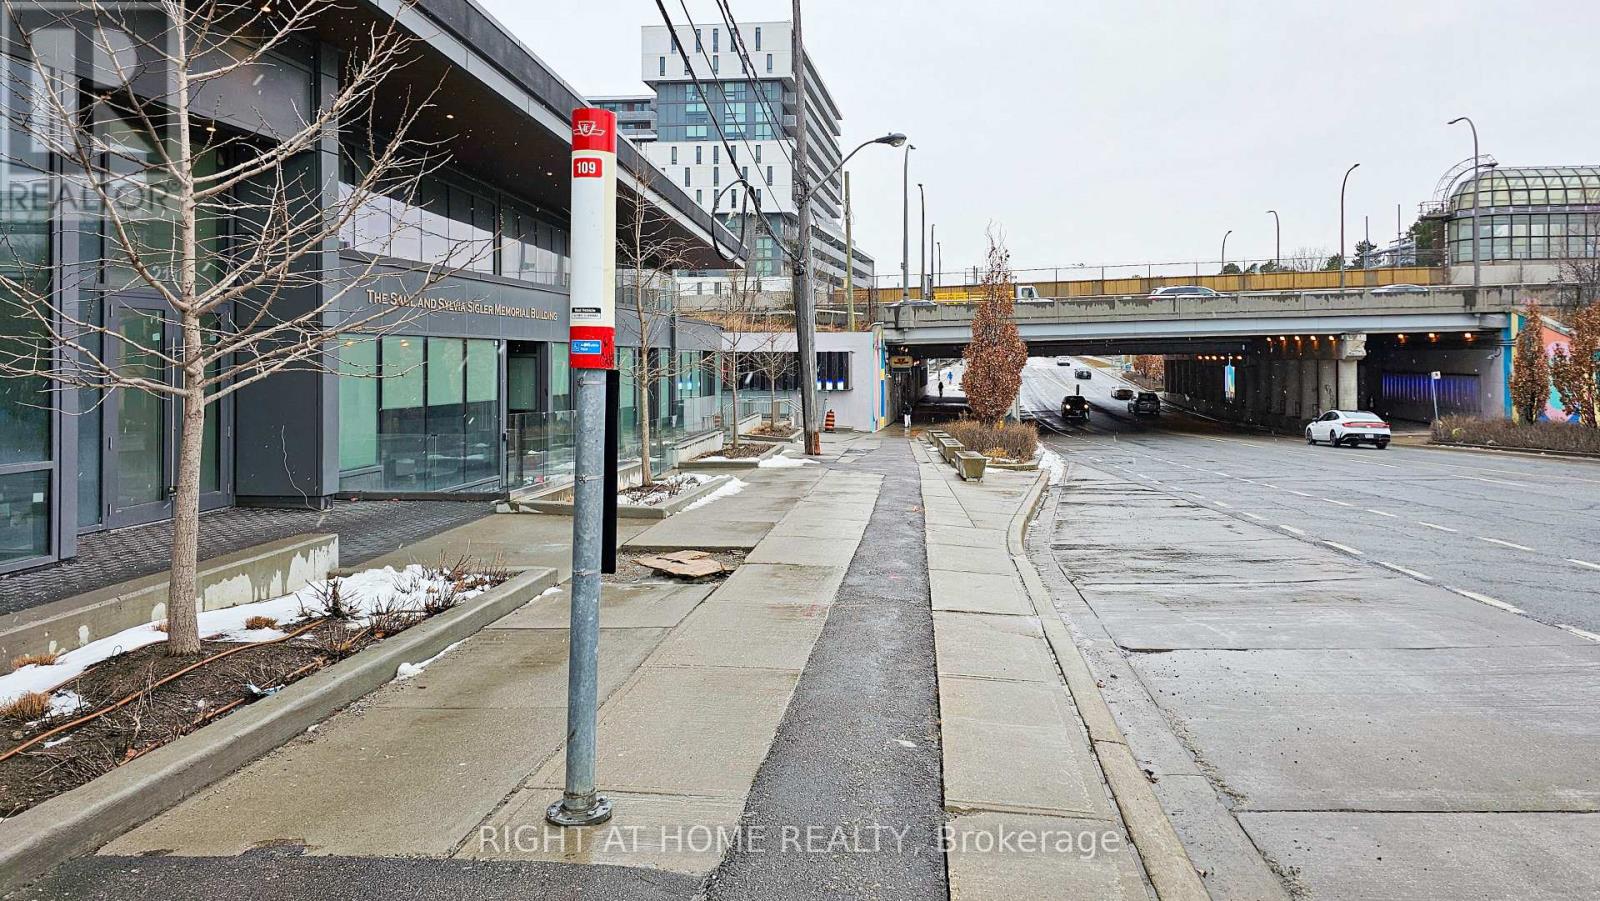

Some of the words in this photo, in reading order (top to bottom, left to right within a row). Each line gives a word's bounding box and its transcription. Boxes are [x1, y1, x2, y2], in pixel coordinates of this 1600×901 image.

[577, 161, 596, 174] 109
[366, 289, 389, 305] THE
[418, 299, 437, 309] AND
[439, 297, 466, 313] SYLVIA
[467, 301, 494, 315] SIGLER
[494, 303, 530, 319] MEMORIAL
[530, 307, 559, 322] BUILDING
